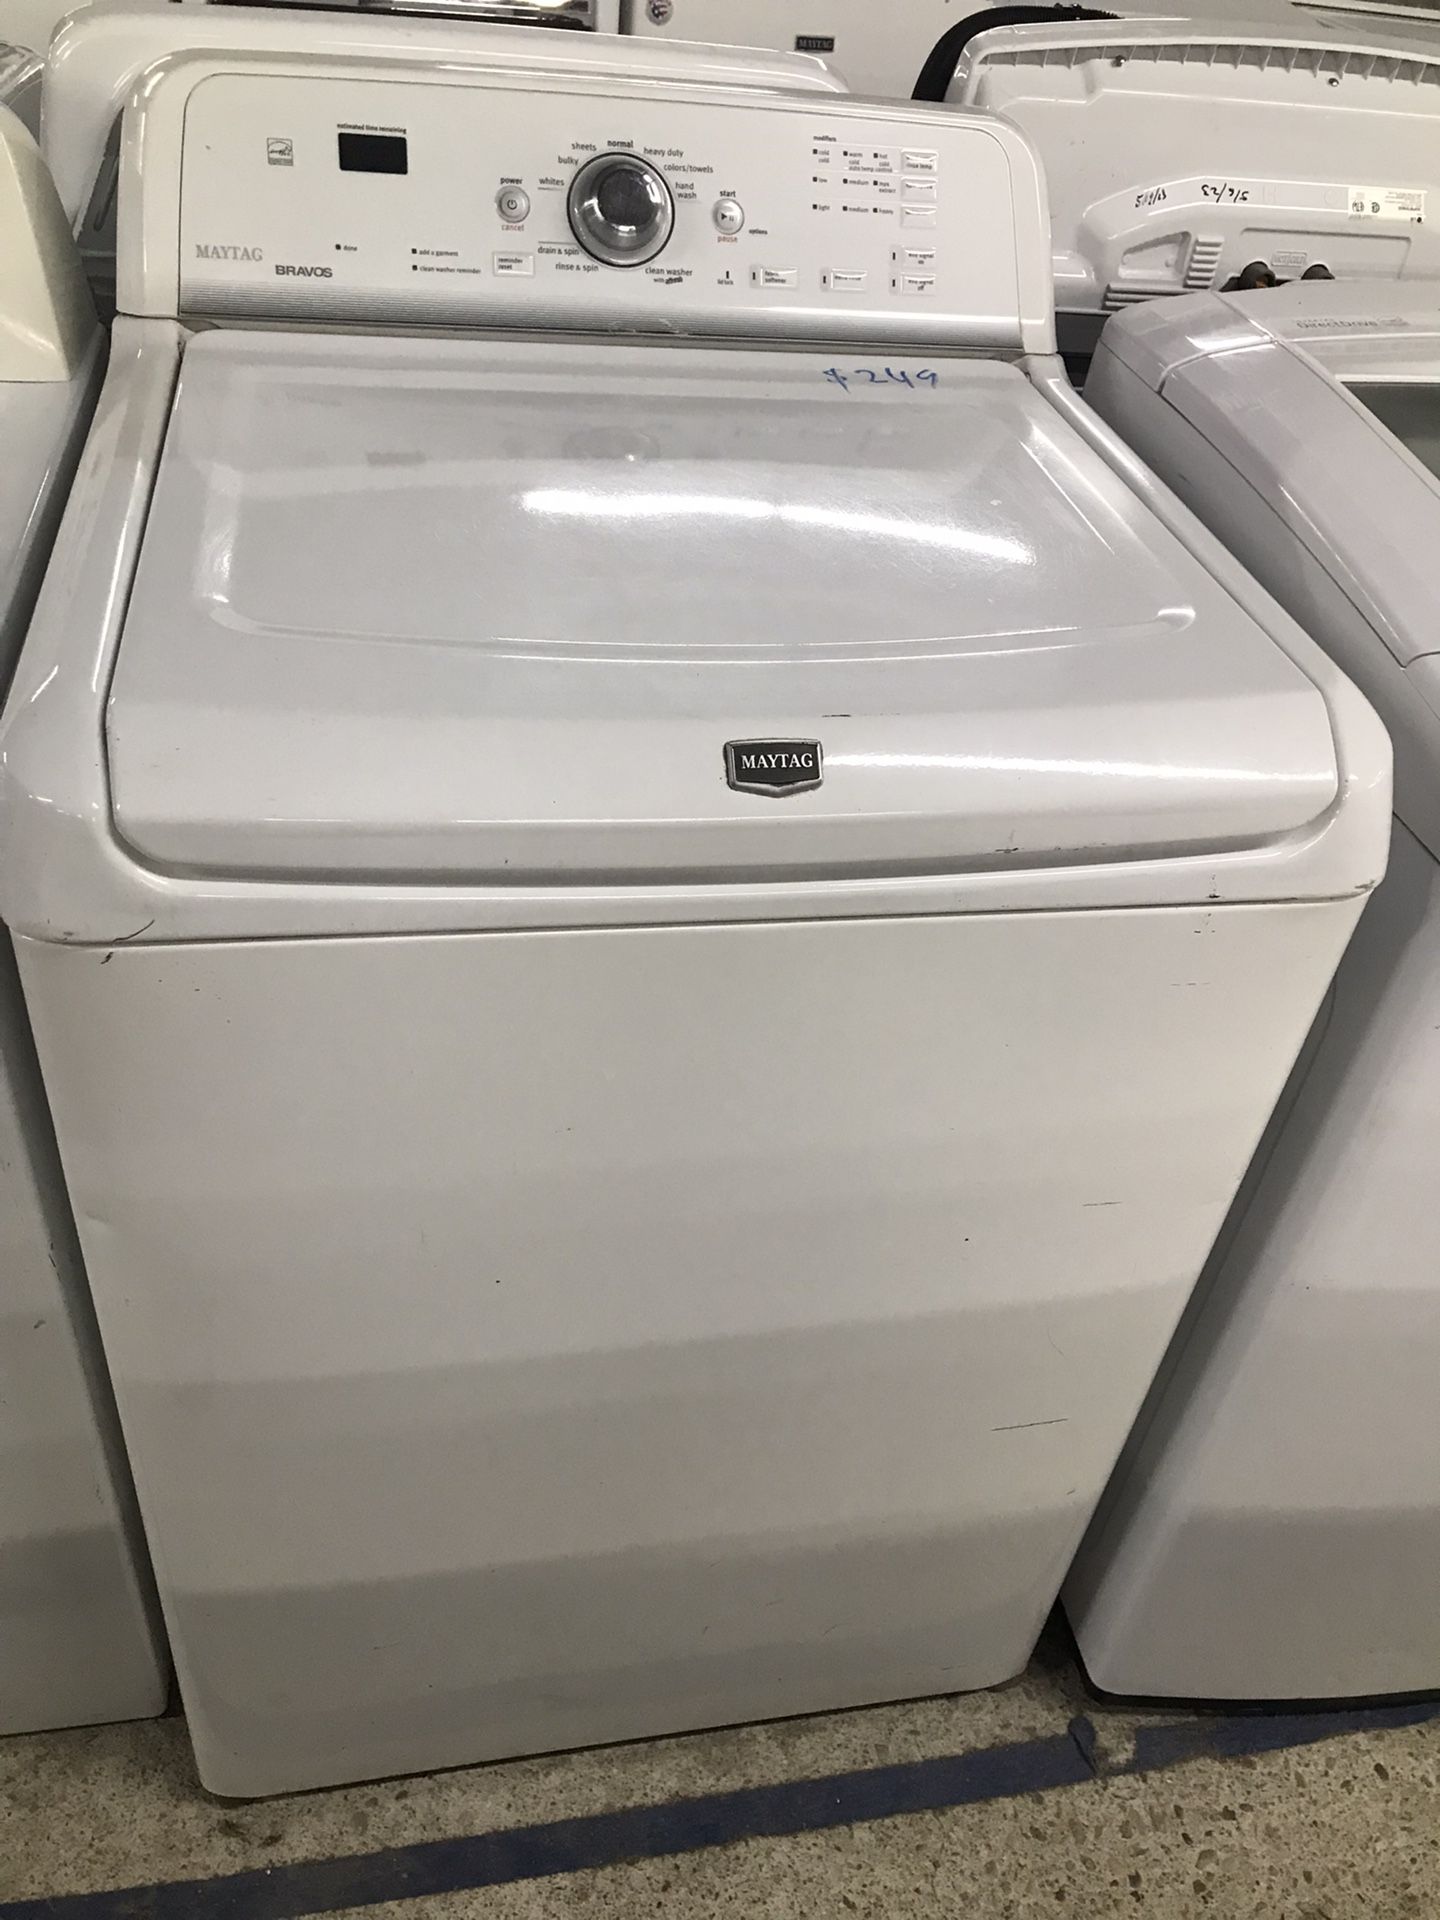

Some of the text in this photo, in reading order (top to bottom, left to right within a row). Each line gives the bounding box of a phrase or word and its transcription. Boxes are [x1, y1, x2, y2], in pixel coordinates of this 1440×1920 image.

[571, 142, 597, 152] sheets
[607, 140, 634, 149] normal
[643, 147, 684, 158] heavy duty
[557, 156, 579, 166] bulky
[663, 163, 714, 174] colors/towels
[500, 177, 523, 185] power
[538, 178, 565, 187] whites
[675, 182, 695, 191] hand
[677, 190, 697, 200] wash
[719, 190, 736, 198] start
[501, 223, 525, 232] cancel
[717, 235, 738, 244] pause
[195, 243, 264, 263] MAYTAG
[537, 246, 557, 255] drain
[563, 247, 580, 257] spin
[275, 264, 333, 278] BRAVOS
[555, 261, 575, 271] rinse
[582, 263, 599, 273] spin
[645, 266, 693, 277] clean washer
[741, 752, 814, 770] MAYTAG
